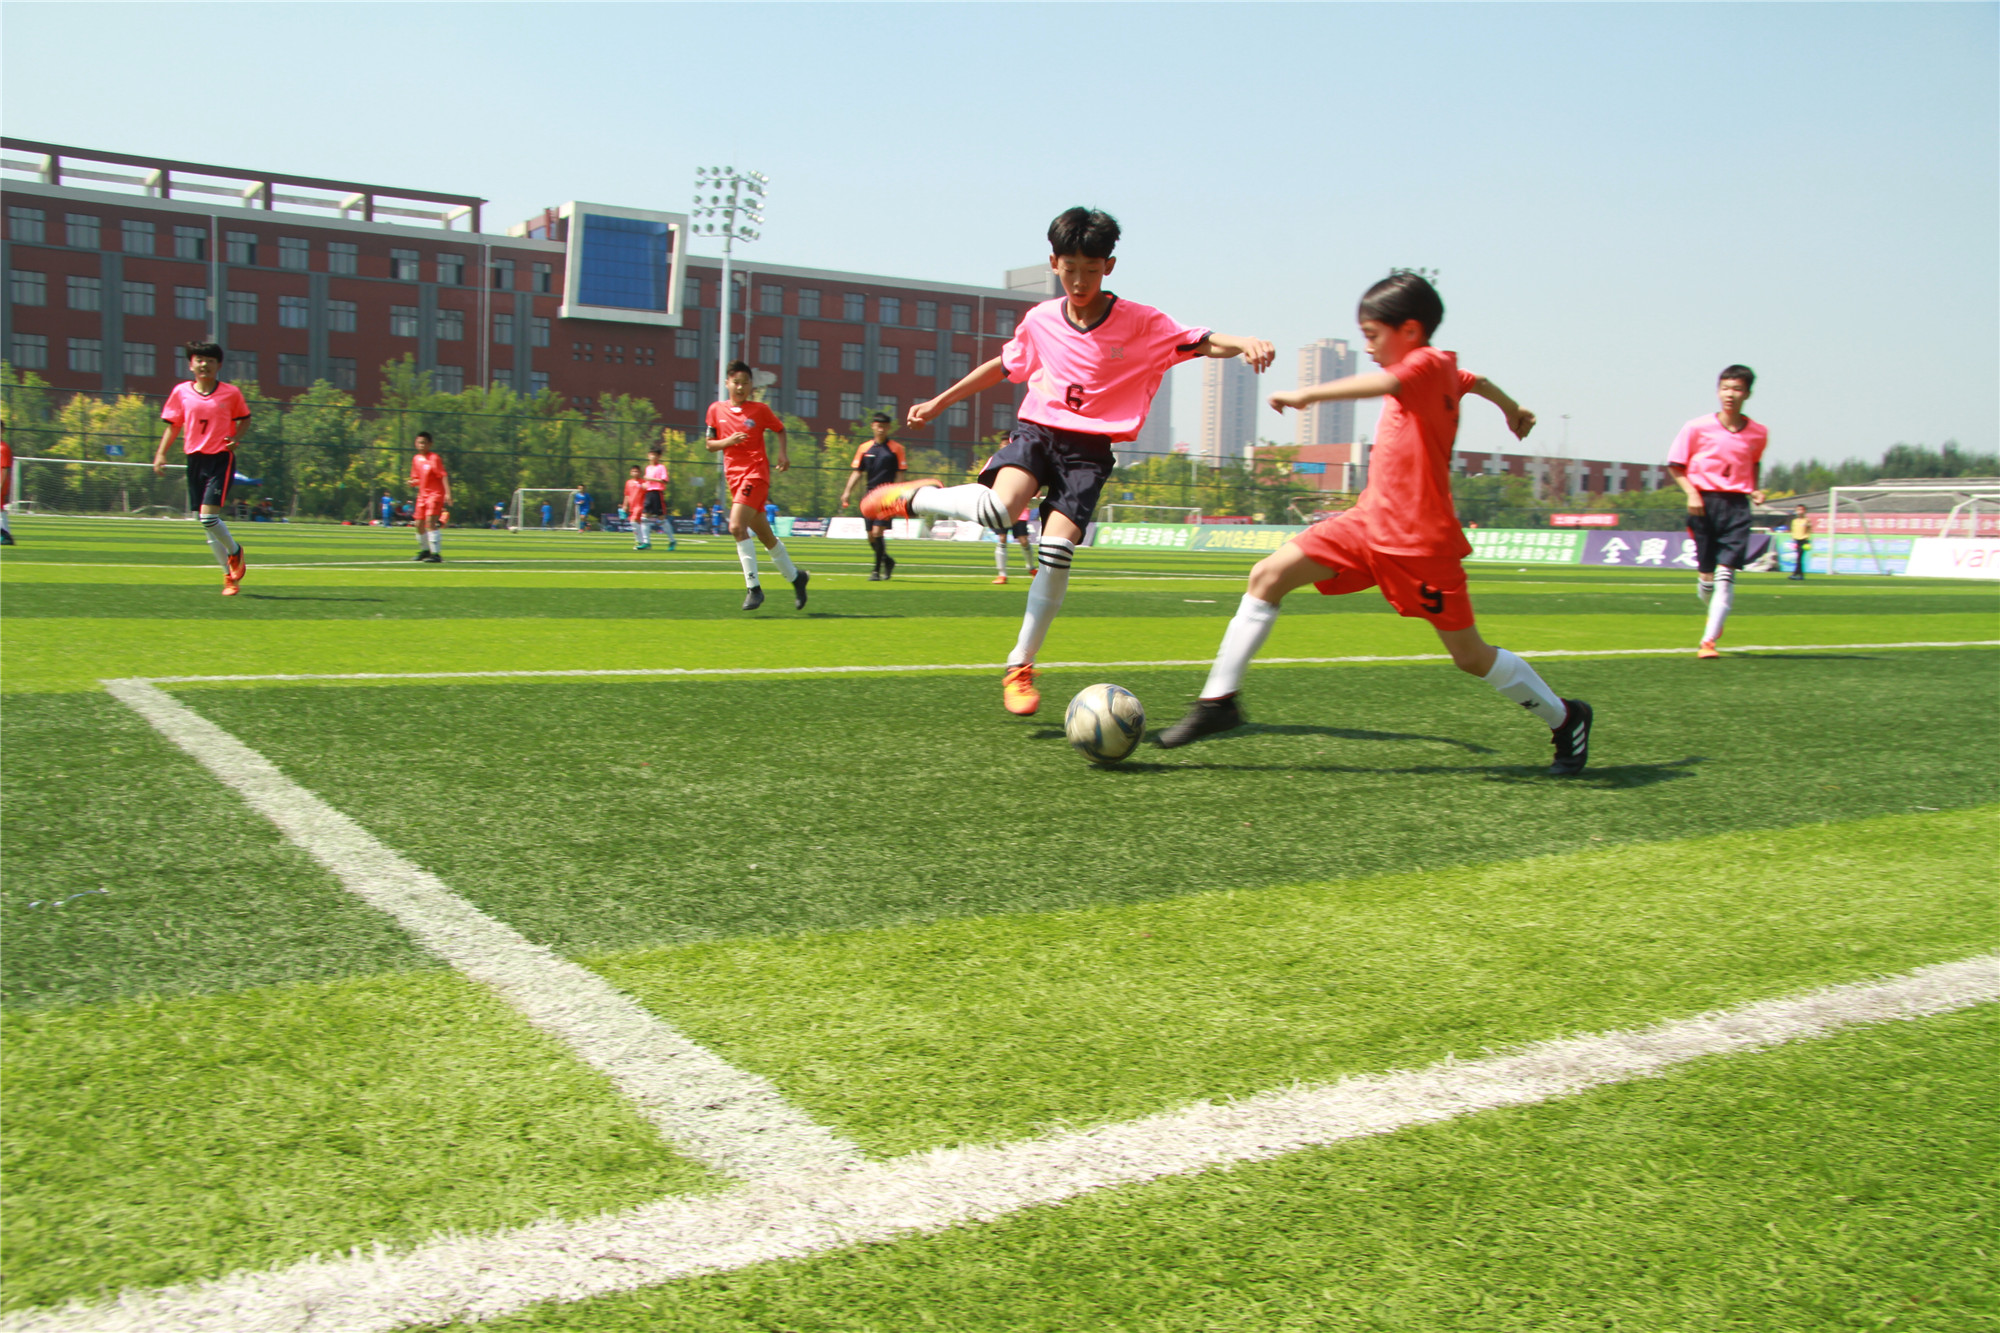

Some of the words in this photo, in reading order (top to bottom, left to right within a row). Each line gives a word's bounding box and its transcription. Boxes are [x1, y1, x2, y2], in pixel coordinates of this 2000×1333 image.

[1065, 384, 1084, 411] 6
[199, 419, 208, 435] 7
[1205, 530, 1298, 550] 2018全国青
[1421, 582, 1443, 614] 9
